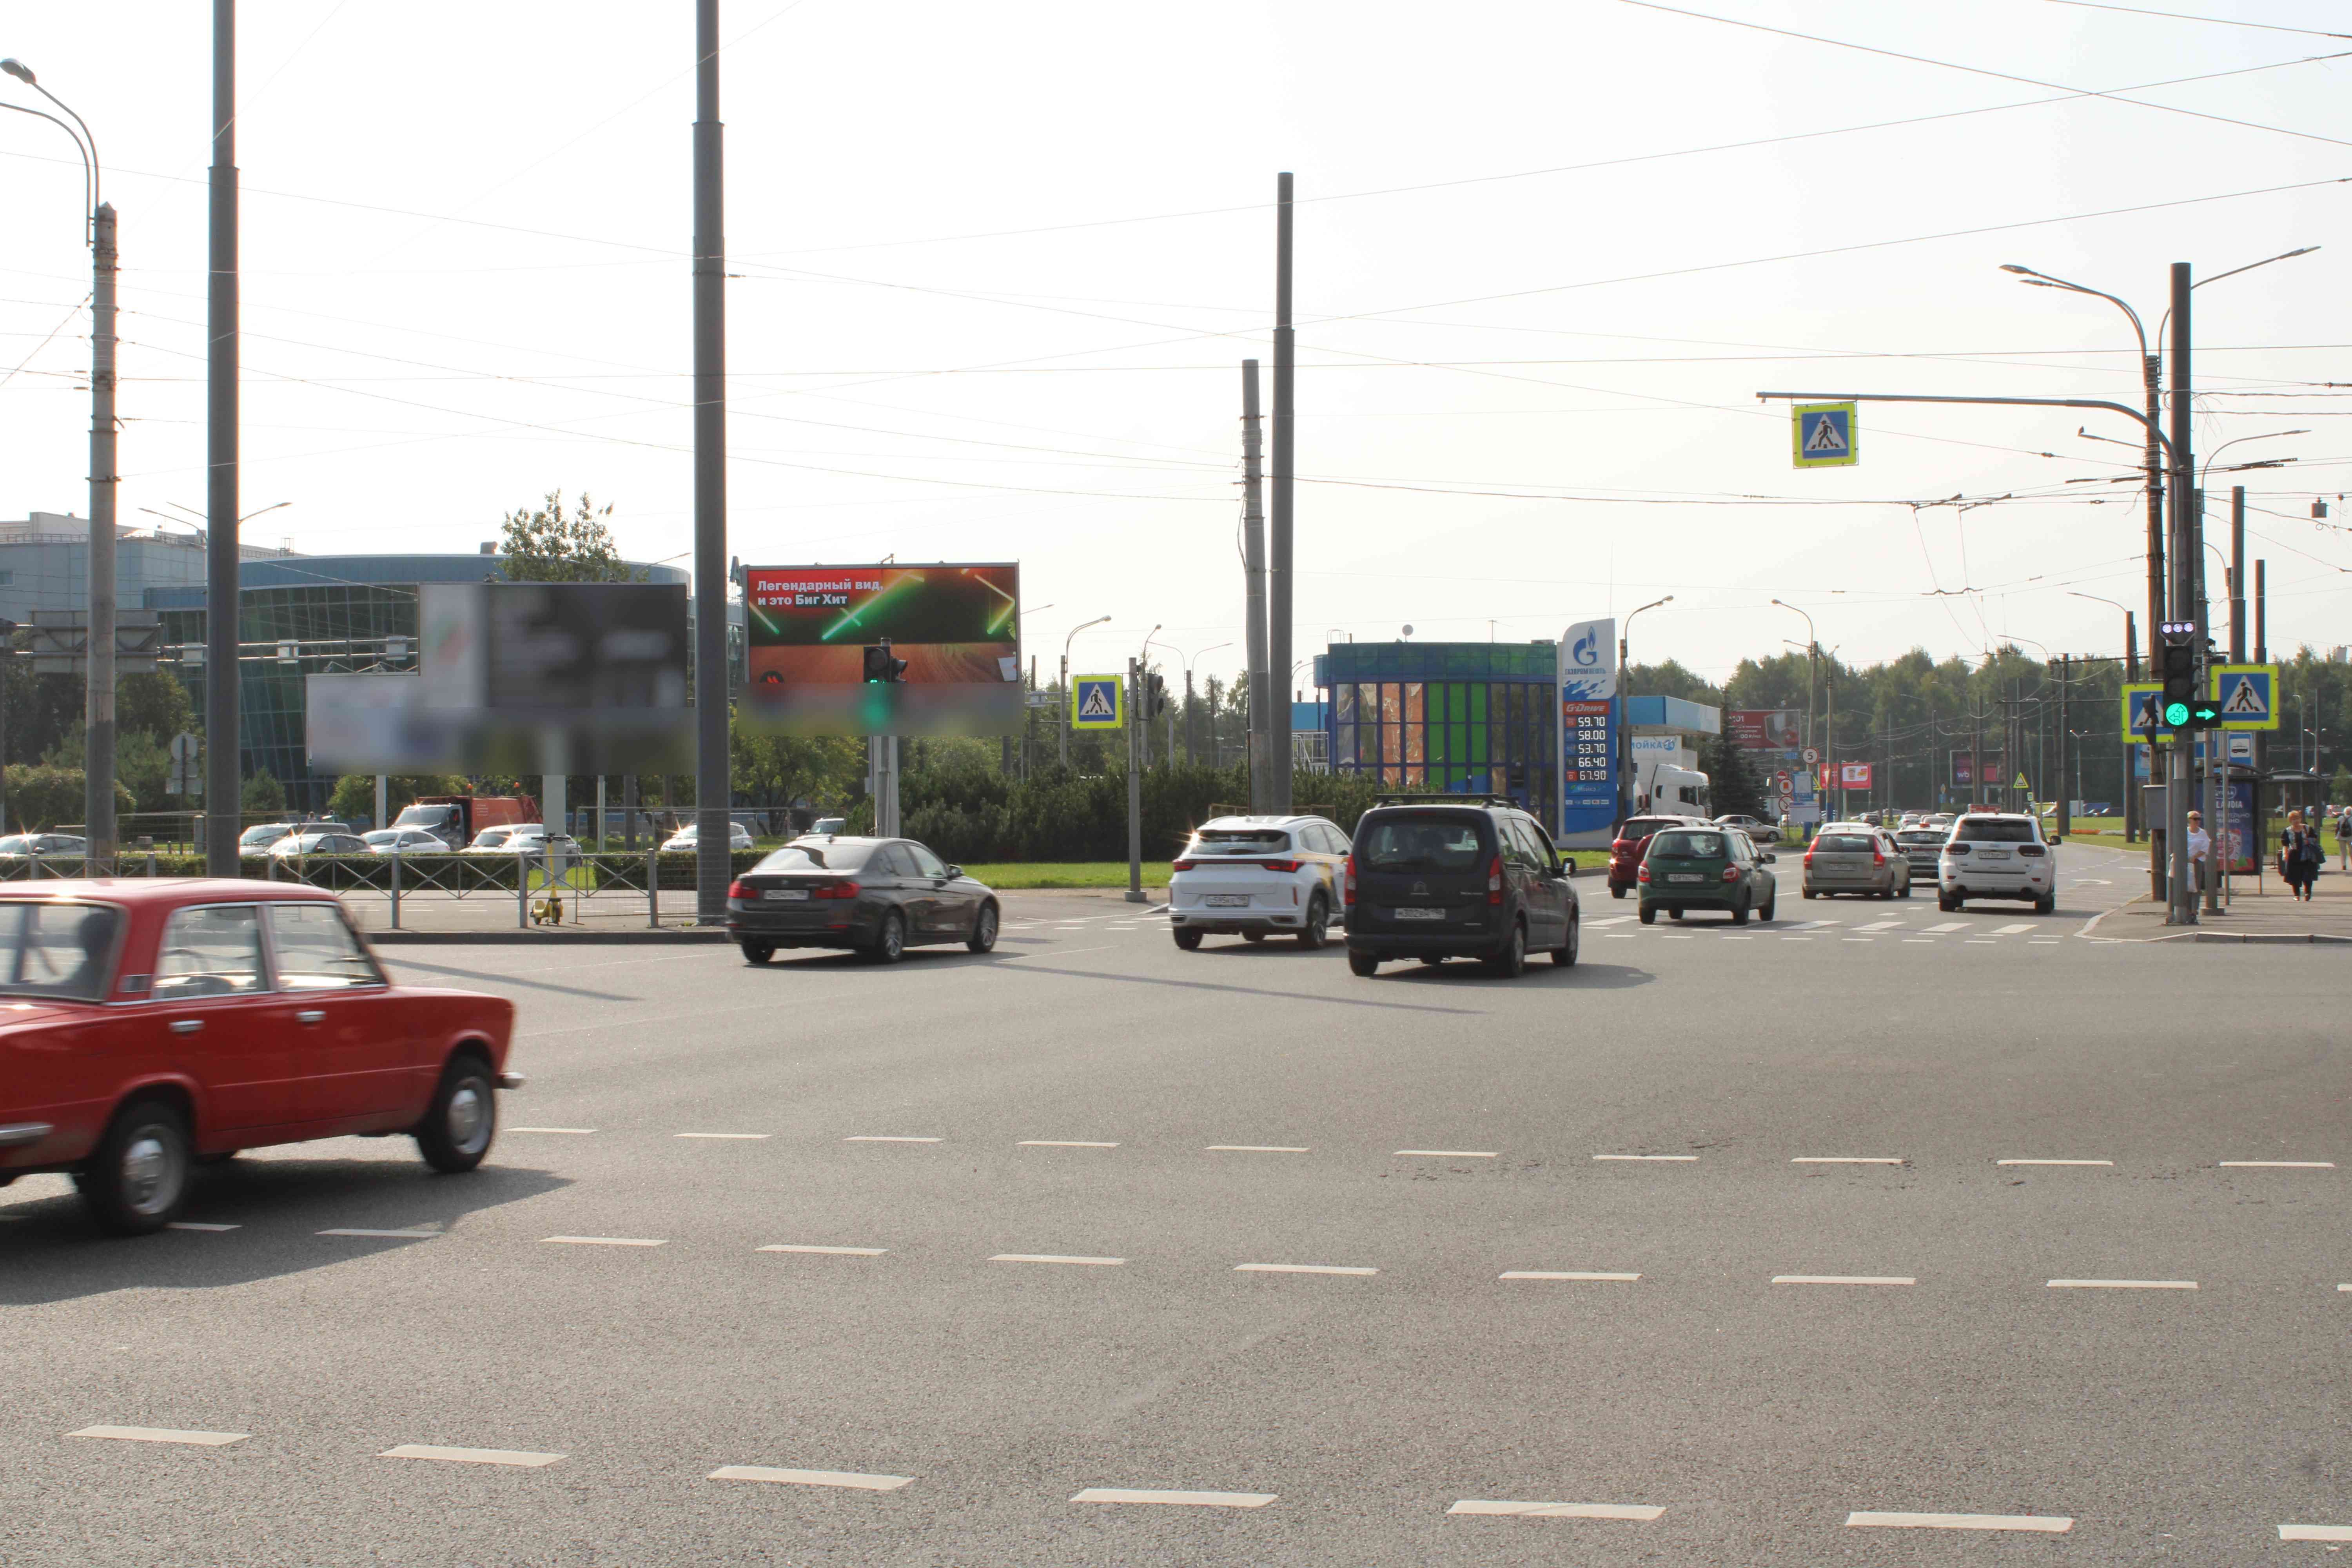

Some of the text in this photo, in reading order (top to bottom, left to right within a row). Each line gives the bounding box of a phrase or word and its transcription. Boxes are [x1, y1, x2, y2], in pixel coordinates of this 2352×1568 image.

[757, 578, 883, 592] Легендарный вид,
[758, 594, 847, 605] и это Биг Хит
[1578, 717, 1605, 727] 59.70
[1578, 730, 1606, 740] 58.00
[1578, 744, 1606, 754] 53.70
[1578, 757, 1606, 768] 66.40
[1579, 771, 1606, 780] 67.90
